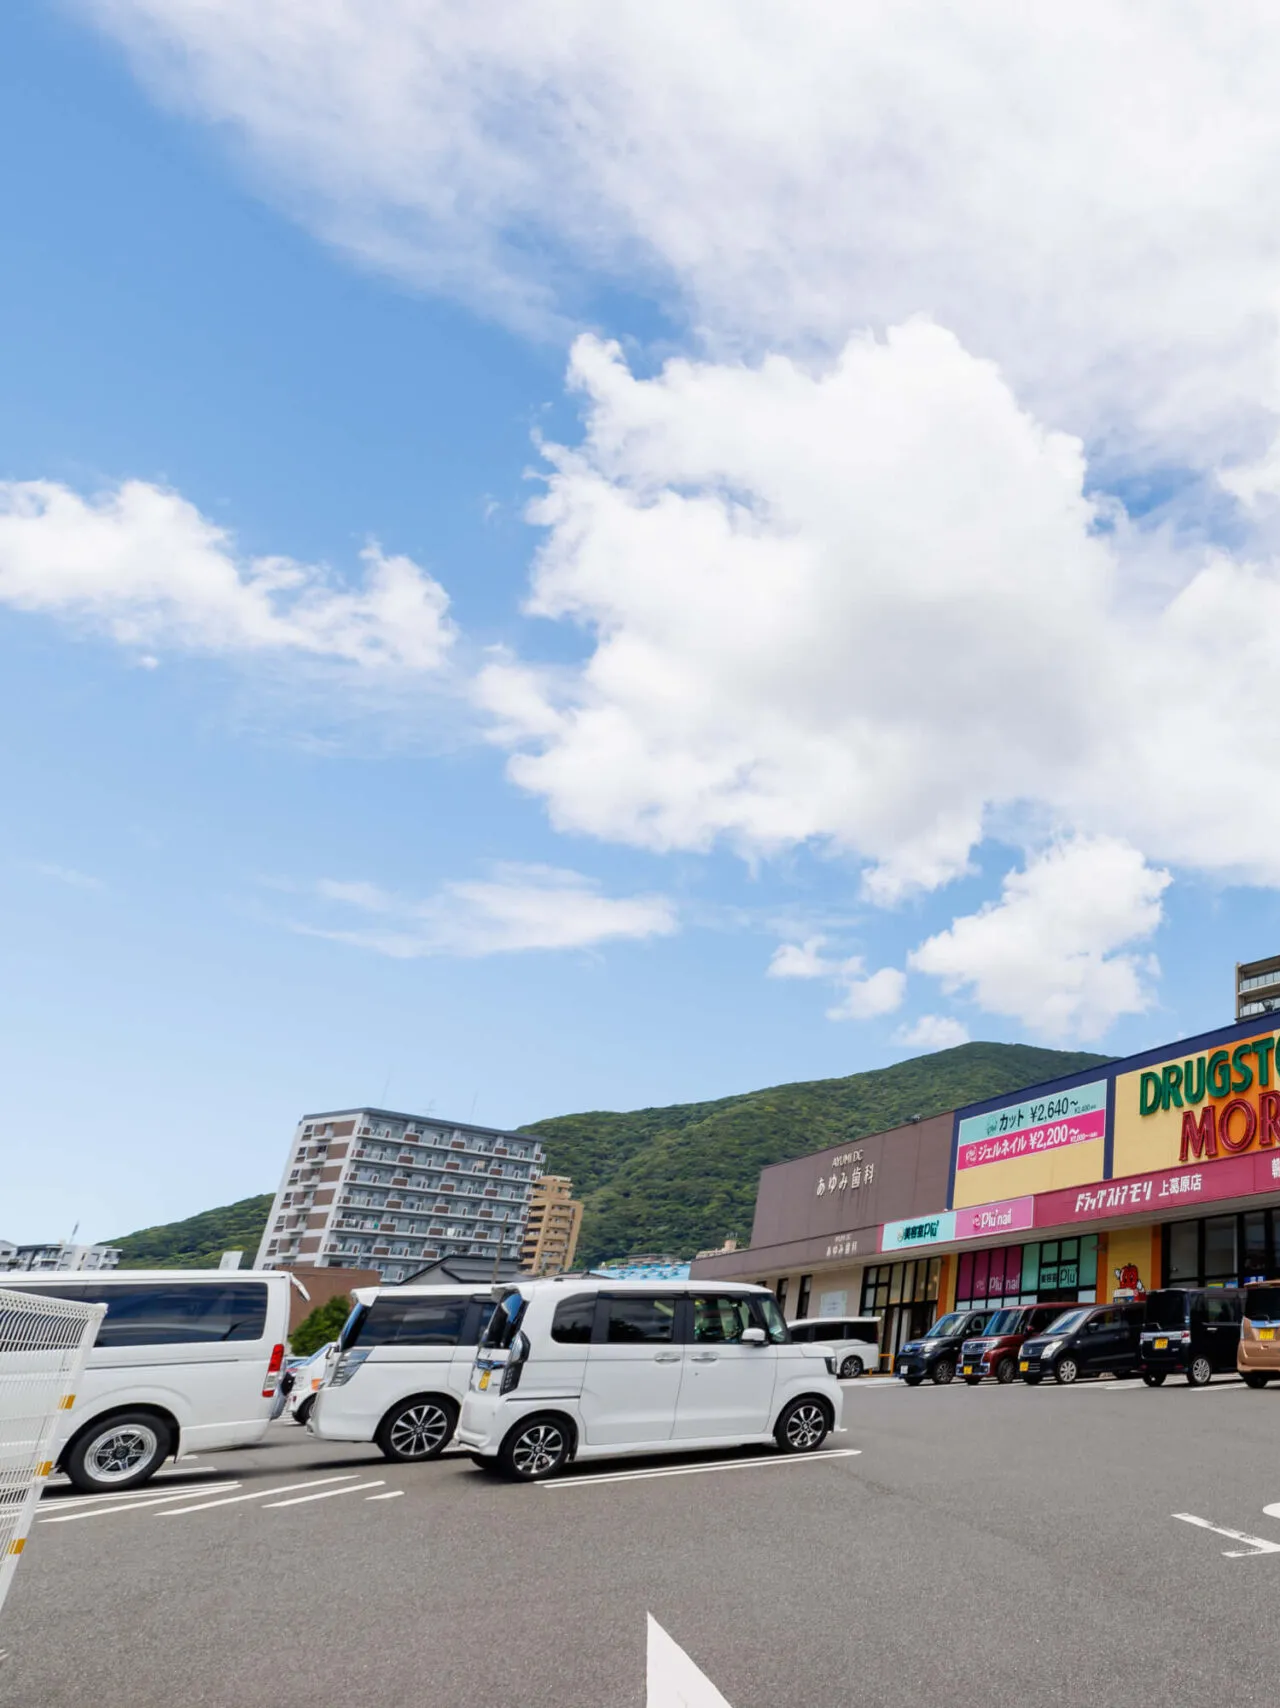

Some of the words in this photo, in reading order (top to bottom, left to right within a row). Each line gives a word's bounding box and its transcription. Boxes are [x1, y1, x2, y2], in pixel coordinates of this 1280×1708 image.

[999, 1108, 1025, 1131] カット
[978, 1136, 1028, 1161] ジェルネイル
[816, 1163, 875, 1196] あゆみ歯科
